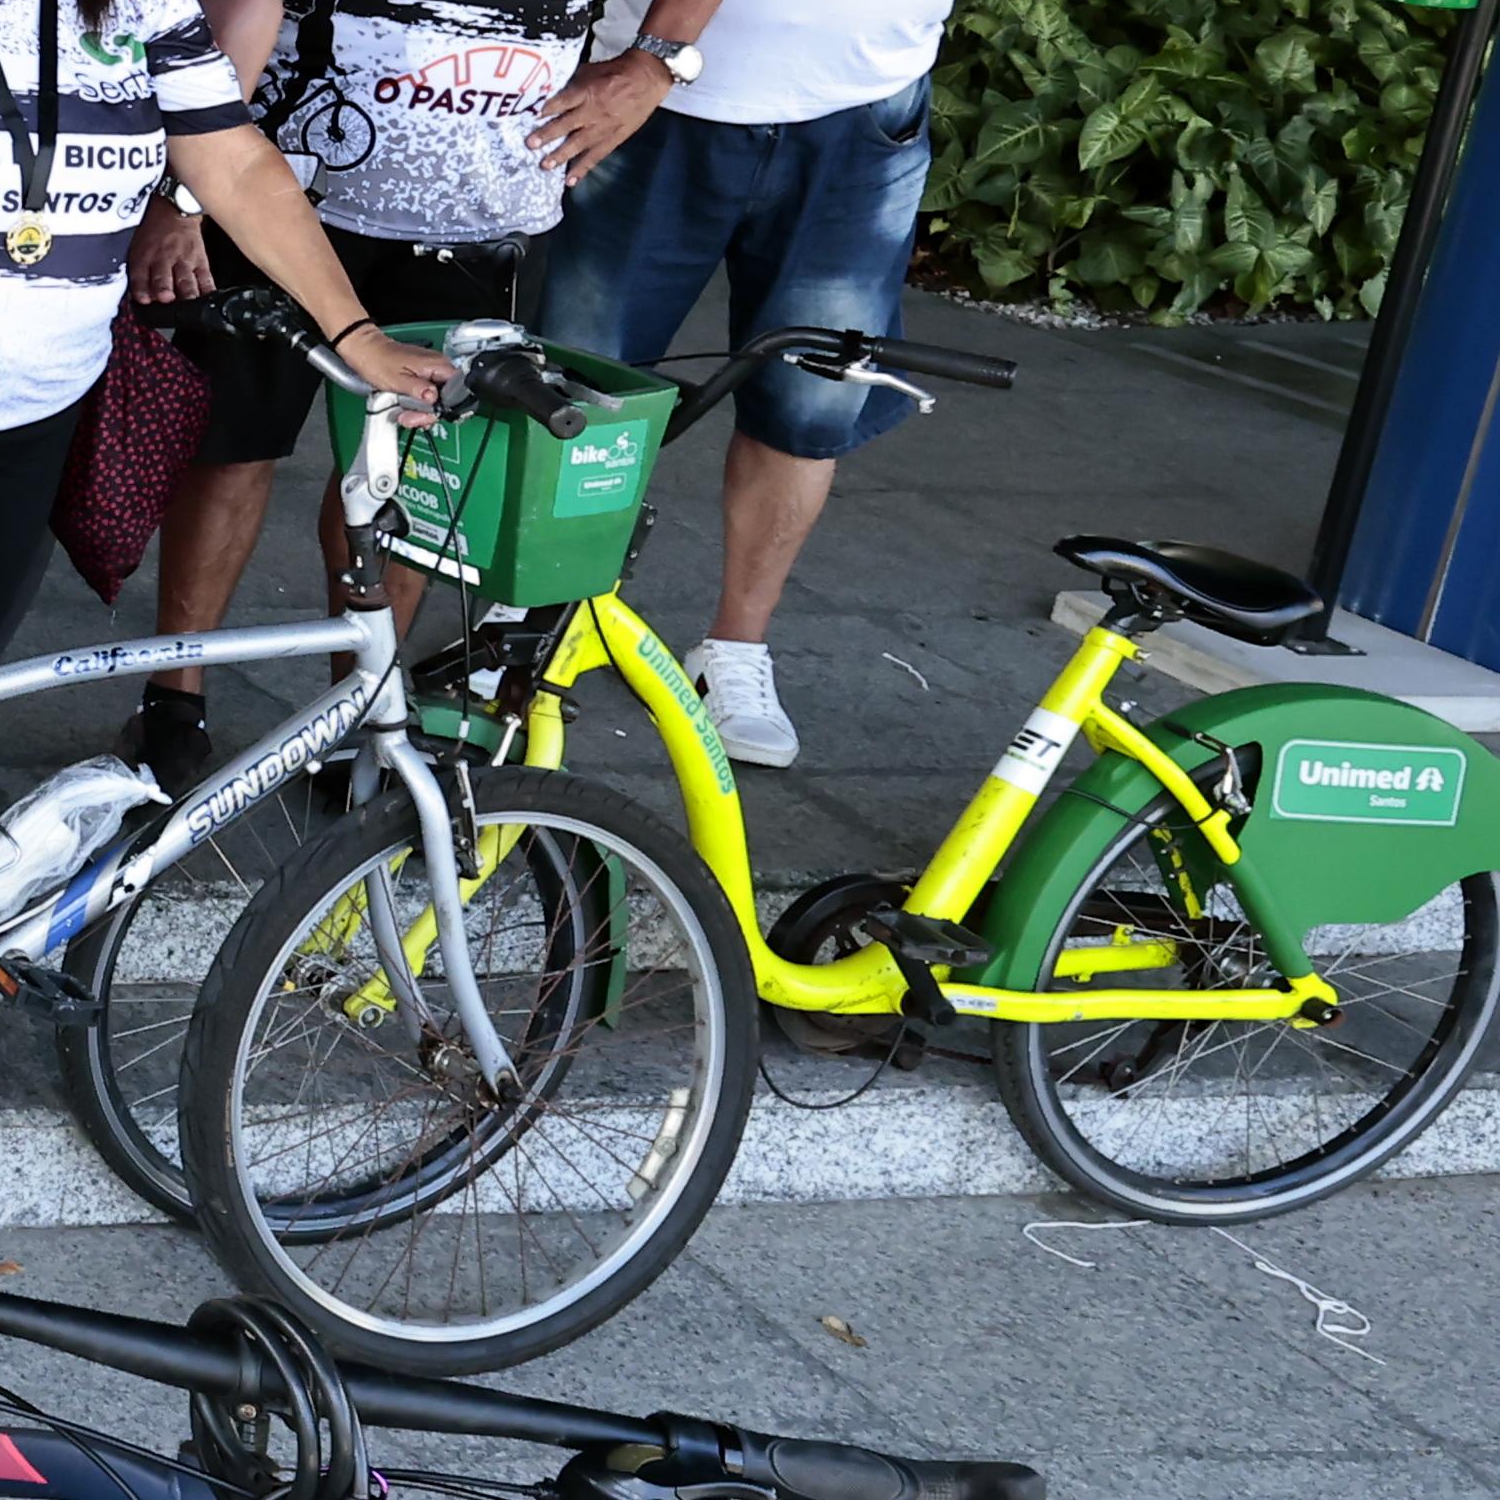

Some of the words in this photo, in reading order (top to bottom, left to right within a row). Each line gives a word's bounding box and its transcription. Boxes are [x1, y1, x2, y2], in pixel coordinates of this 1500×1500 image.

[65, 145, 166, 172] BICICLE
[3, 191, 117, 215] SNTOS
[571, 444, 608, 466] bike
[636, 633, 700, 721] Unimed
[695, 716, 736, 796] Santos
[185, 686, 371, 845] SUNDOWN
[1298, 759, 1413, 791] Unimed
[1369, 794, 1407, 809] Santos
